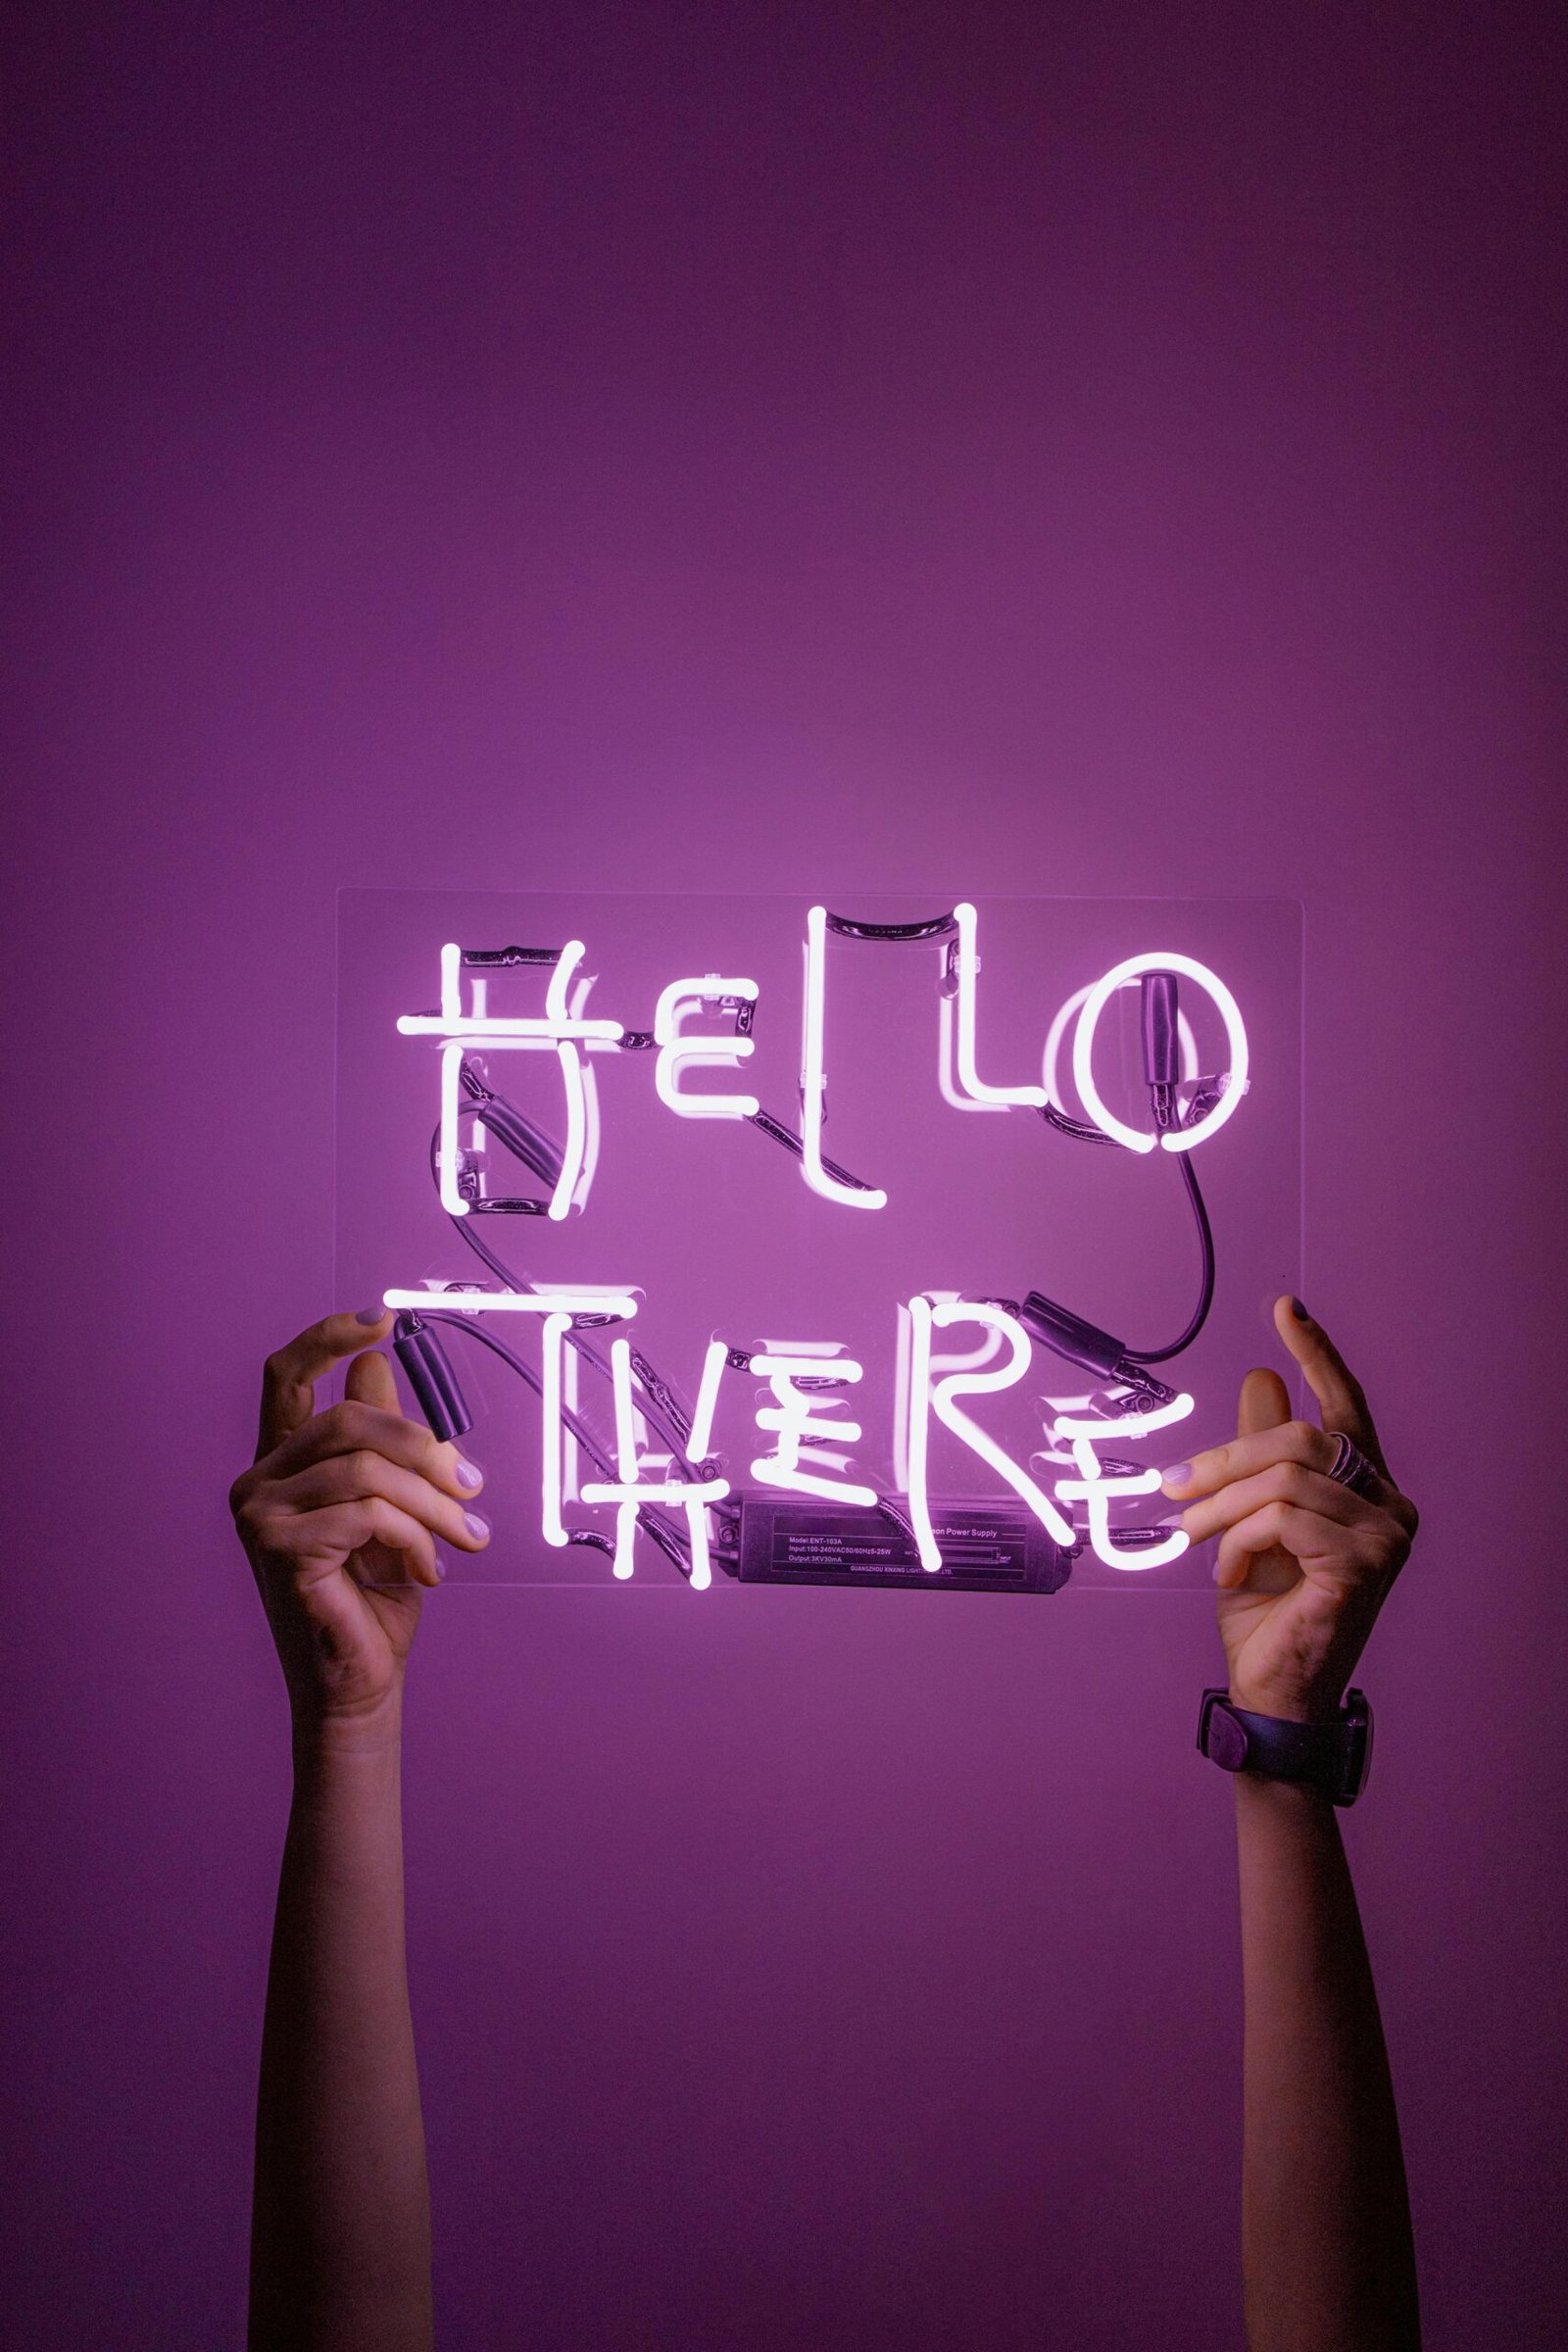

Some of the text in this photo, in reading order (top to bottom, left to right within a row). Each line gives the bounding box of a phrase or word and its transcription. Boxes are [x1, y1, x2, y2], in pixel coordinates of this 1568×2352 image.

[382, 1287, 1196, 1591] THERE
[946, 1527, 969, 1537] Power
[971, 1528, 998, 1539] Supply
